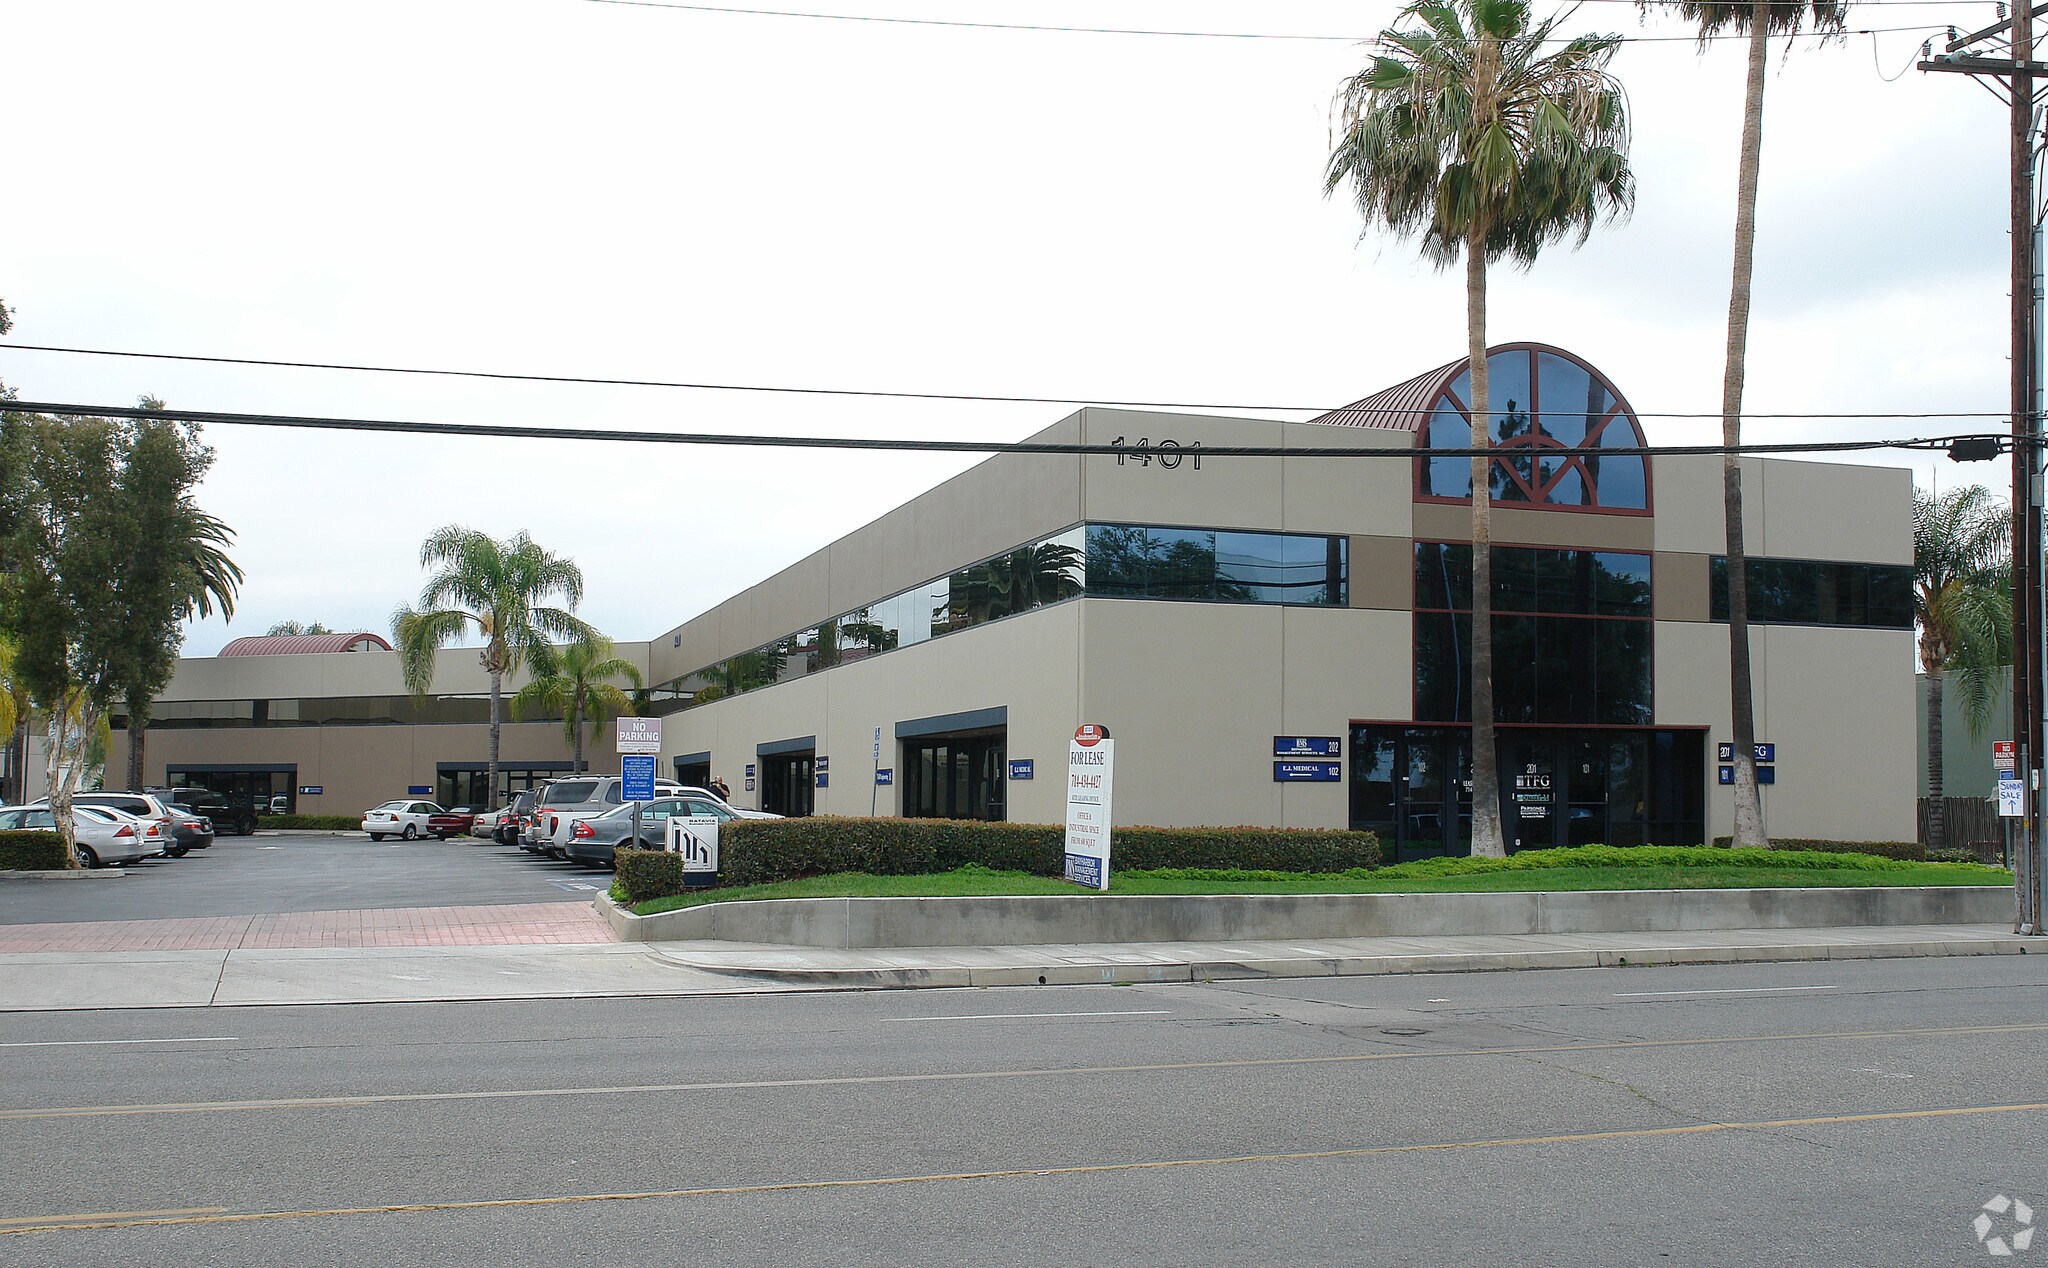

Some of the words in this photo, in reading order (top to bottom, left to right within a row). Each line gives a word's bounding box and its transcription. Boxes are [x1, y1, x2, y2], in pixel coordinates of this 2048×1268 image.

[1111, 436, 1201, 470] 1401
[632, 722, 646, 731] NO
[619, 731, 659, 741] PARKING
[1328, 741, 1339, 753] 202
[1720, 746, 1730, 758] 201
[1070, 751, 1084, 765] FOR
[1084, 751, 1105, 766] LEASE
[1328, 766, 1339, 776] 102
[1524, 775, 1550, 786] TFG
[2000, 792, 2021, 800] SALE
